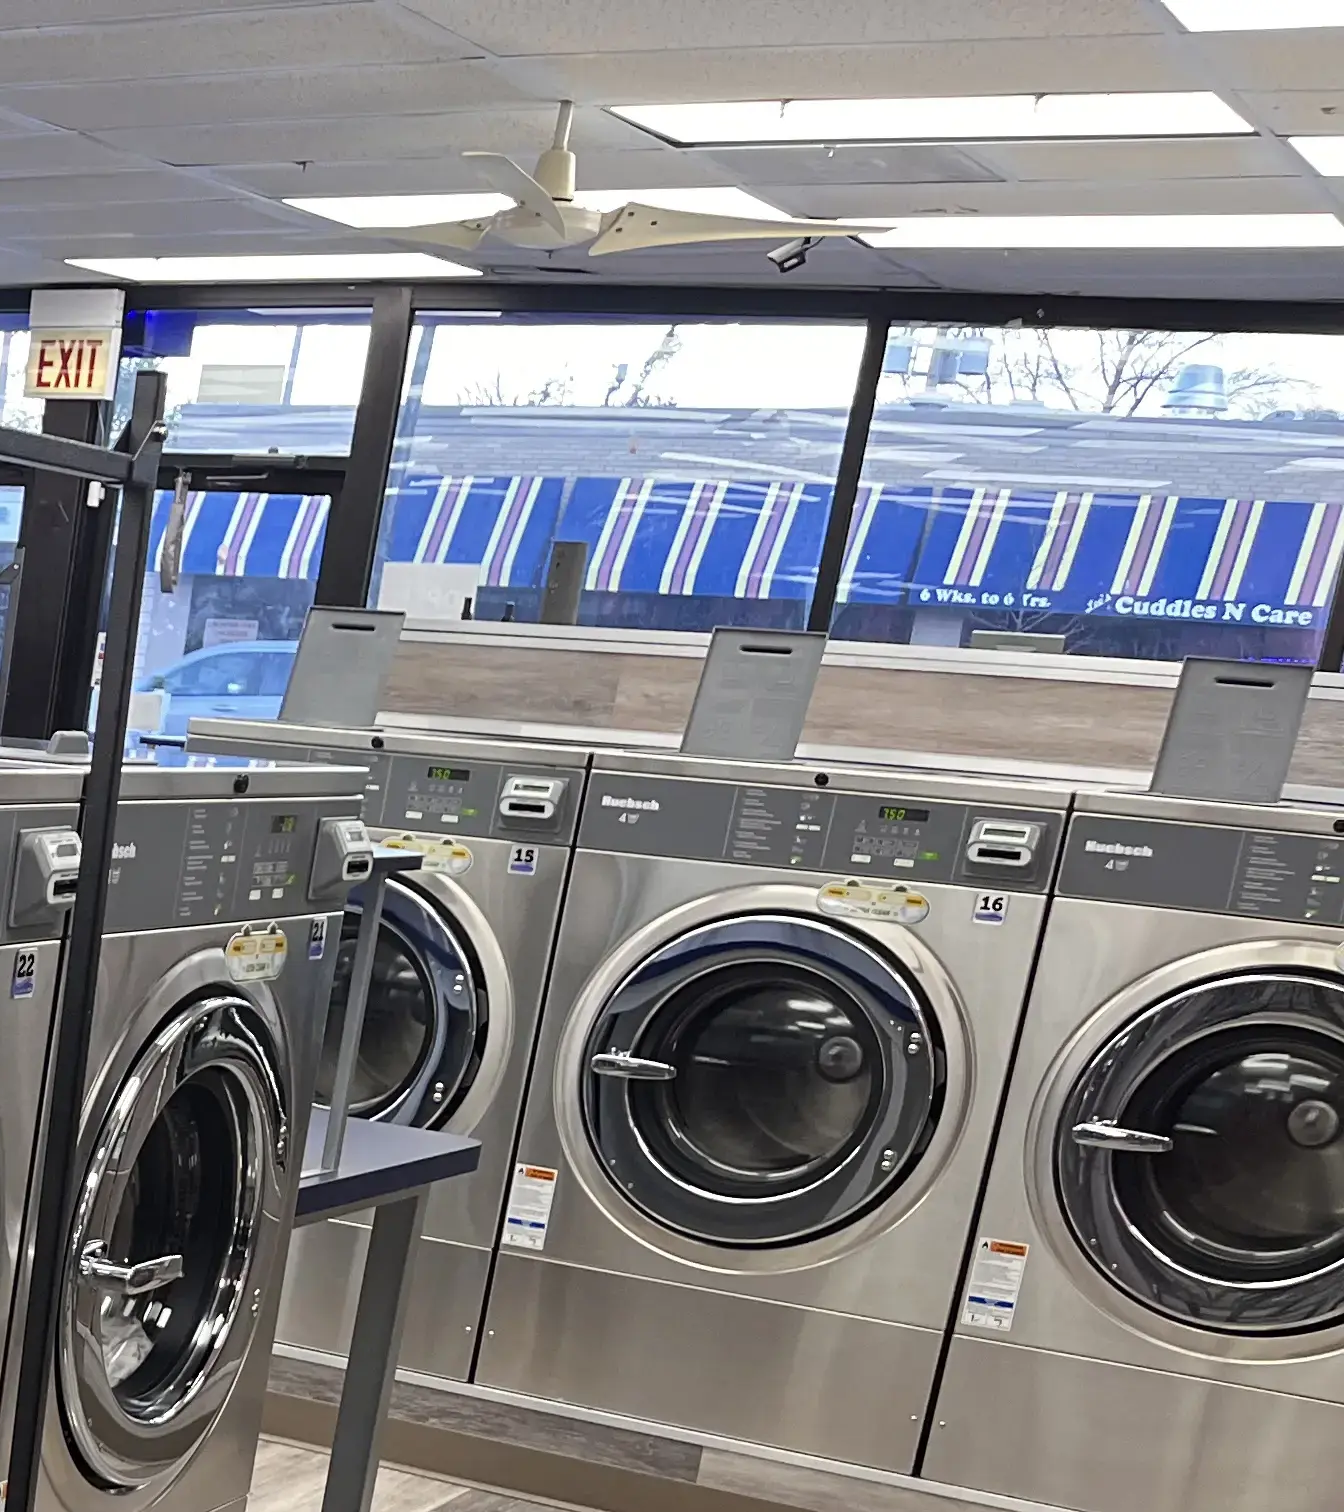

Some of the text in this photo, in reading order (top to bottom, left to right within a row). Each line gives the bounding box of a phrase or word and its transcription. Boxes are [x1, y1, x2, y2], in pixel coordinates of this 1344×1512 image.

[36, 339, 103, 388] EXIT
[919, 588, 931, 602] 6
[935, 588, 977, 604] Wks.
[981, 591, 1000, 606] to
[1003, 592, 1015, 606] 6
[1115, 596, 1218, 620] Cuddles
[1221, 602, 1247, 622] N
[1251, 603, 1313, 626] Care
[514, 848, 535, 863] 15
[979, 895, 1004, 912] 16
[312, 921, 325, 942] 21
[17, 953, 36, 978] 22
